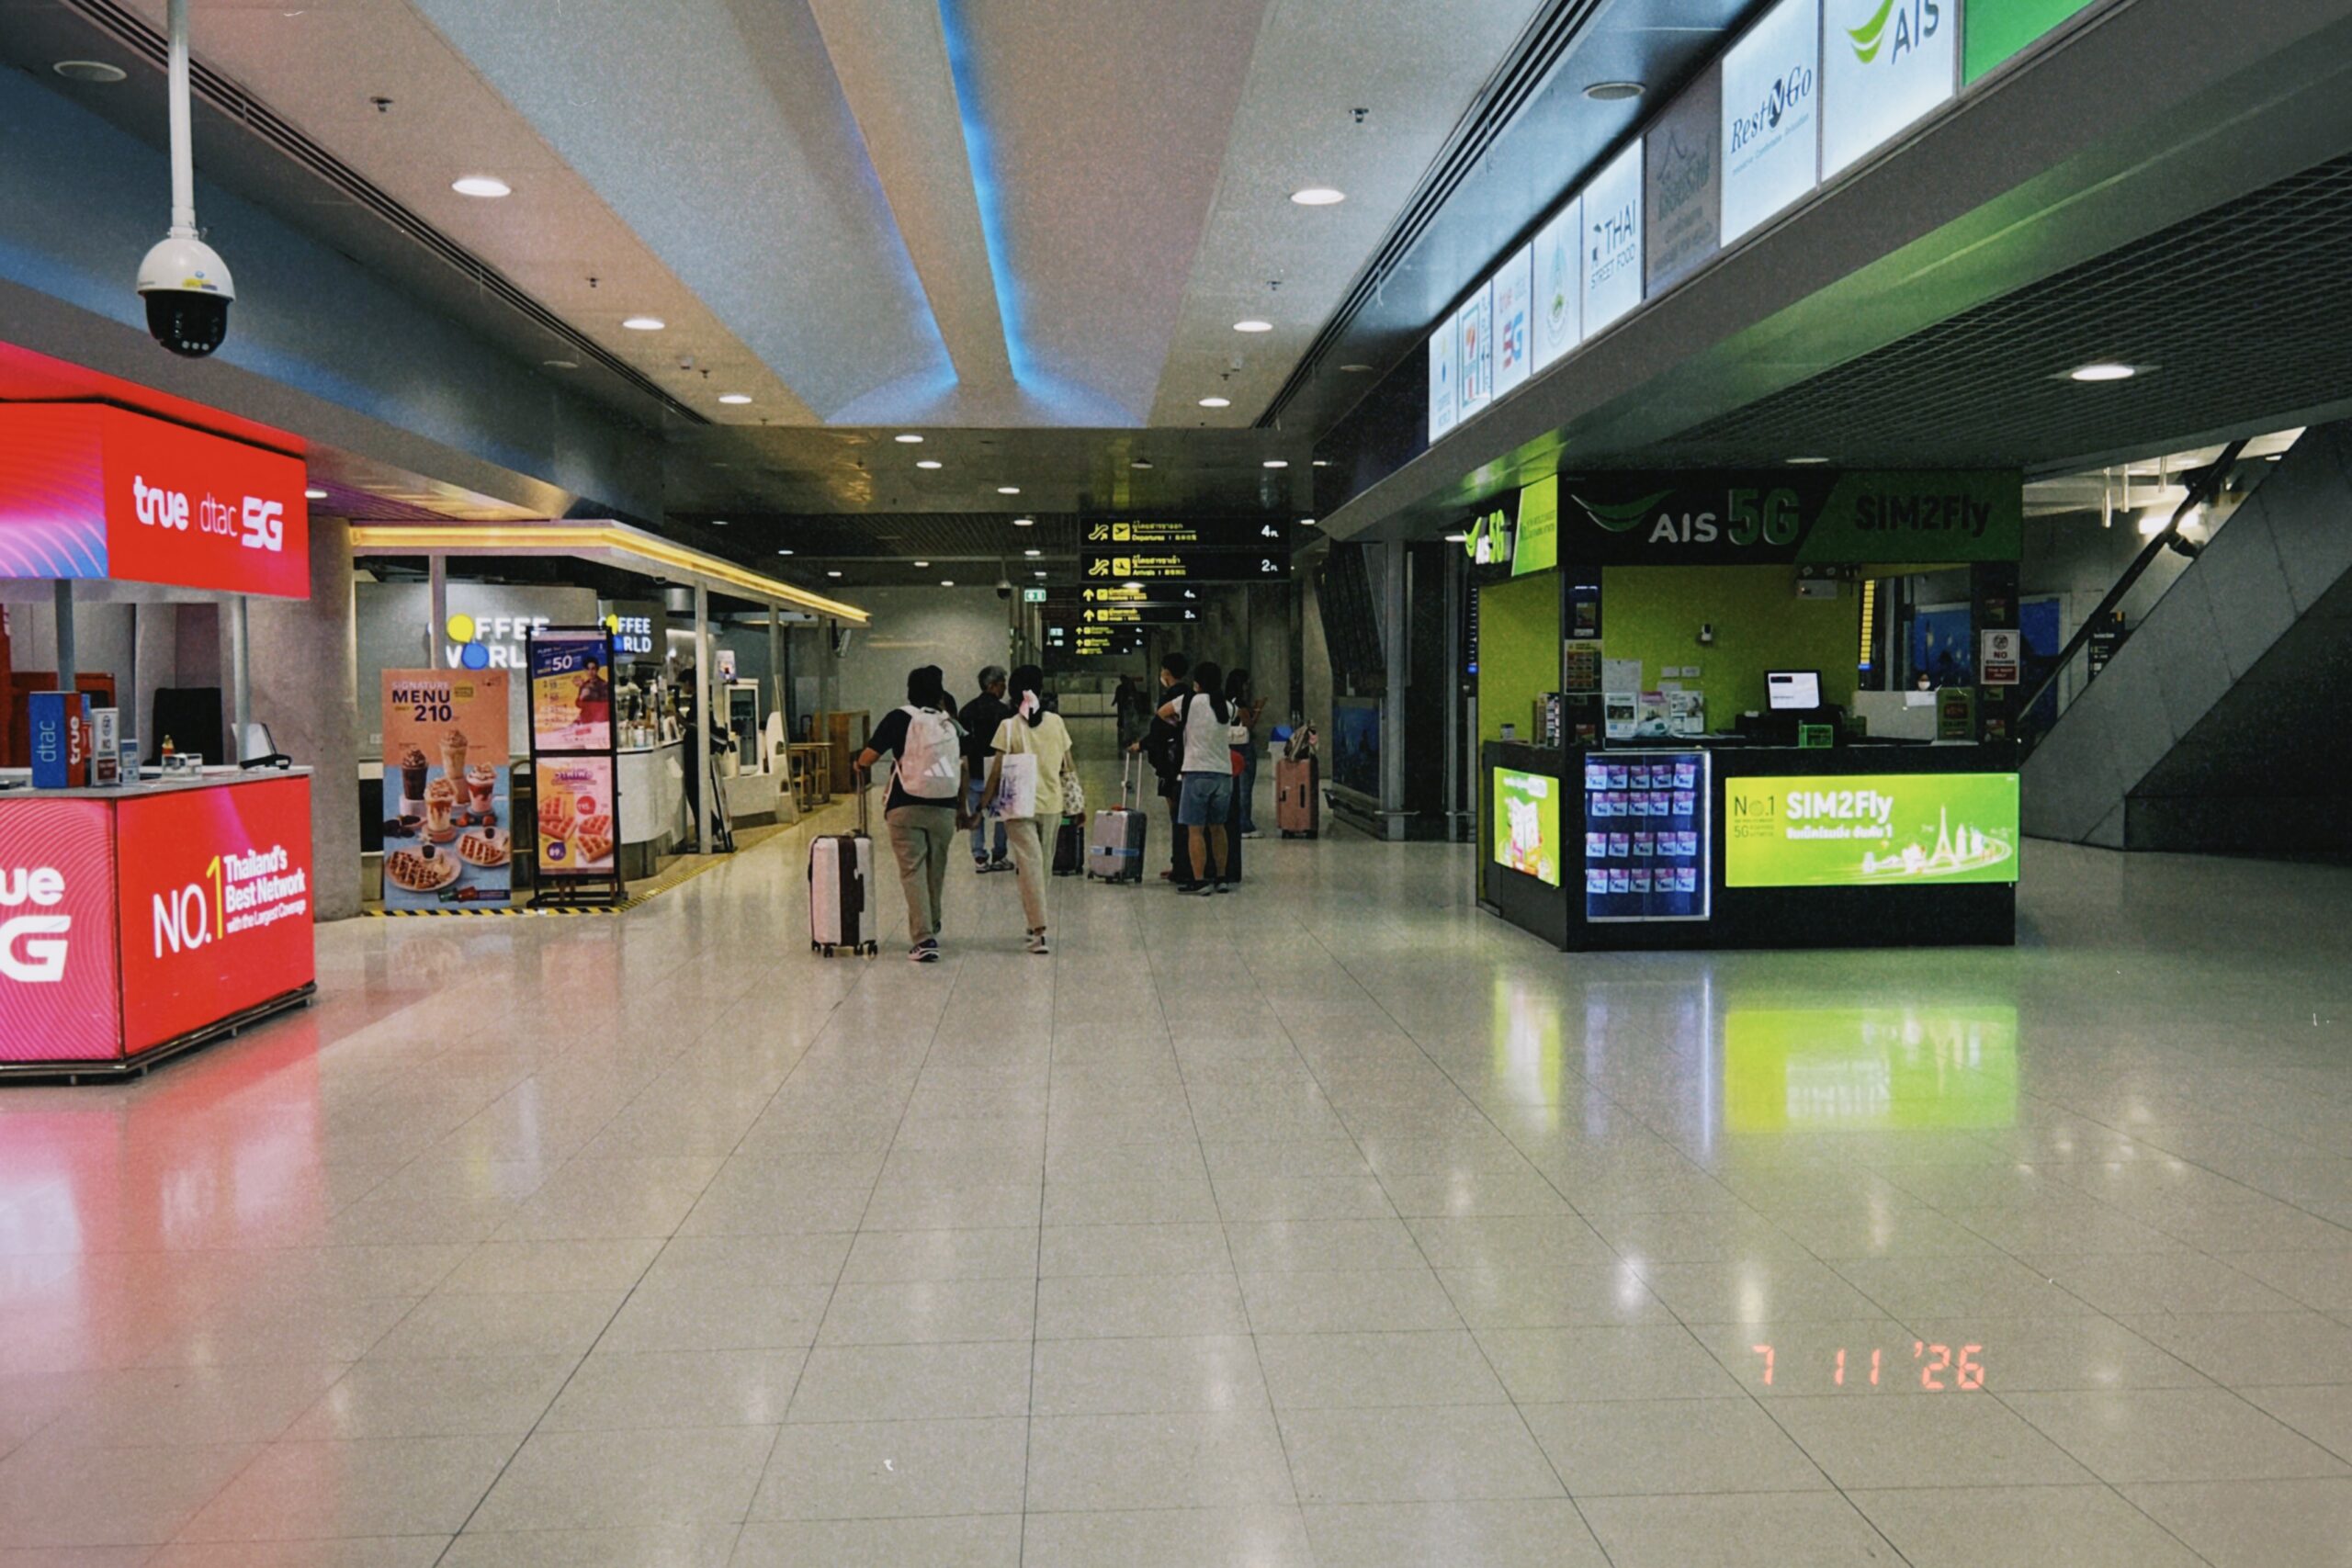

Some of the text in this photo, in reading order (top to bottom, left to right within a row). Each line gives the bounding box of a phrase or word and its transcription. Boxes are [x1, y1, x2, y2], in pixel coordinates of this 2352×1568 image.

[1892, 0, 1939, 65] AIS
[1604, 199, 1636, 254] THAI
[1617, 243, 1635, 272] FOOD
[133, 475, 283, 552] true dtac 5G
[1648, 488, 1800, 546] AIS 5G
[1855, 494, 1991, 538] SIM2Fly
[427, 614, 550, 641] OFFEE
[447, 641, 528, 670] WORL
[613, 636, 652, 653] ORLD
[552, 655, 573, 671] 50
[392, 682, 449, 690] SIGNATURE
[392, 690, 450, 704] MENU
[414, 705, 452, 722] 210
[36, 720, 56, 762] dtac
[70, 716, 81, 765] true
[1786, 791, 1894, 824] SIM2Fly
[1734, 825, 1749, 839] 5G
[223, 844, 288, 884] Thailand's
[225, 867, 306, 913] Best Network
